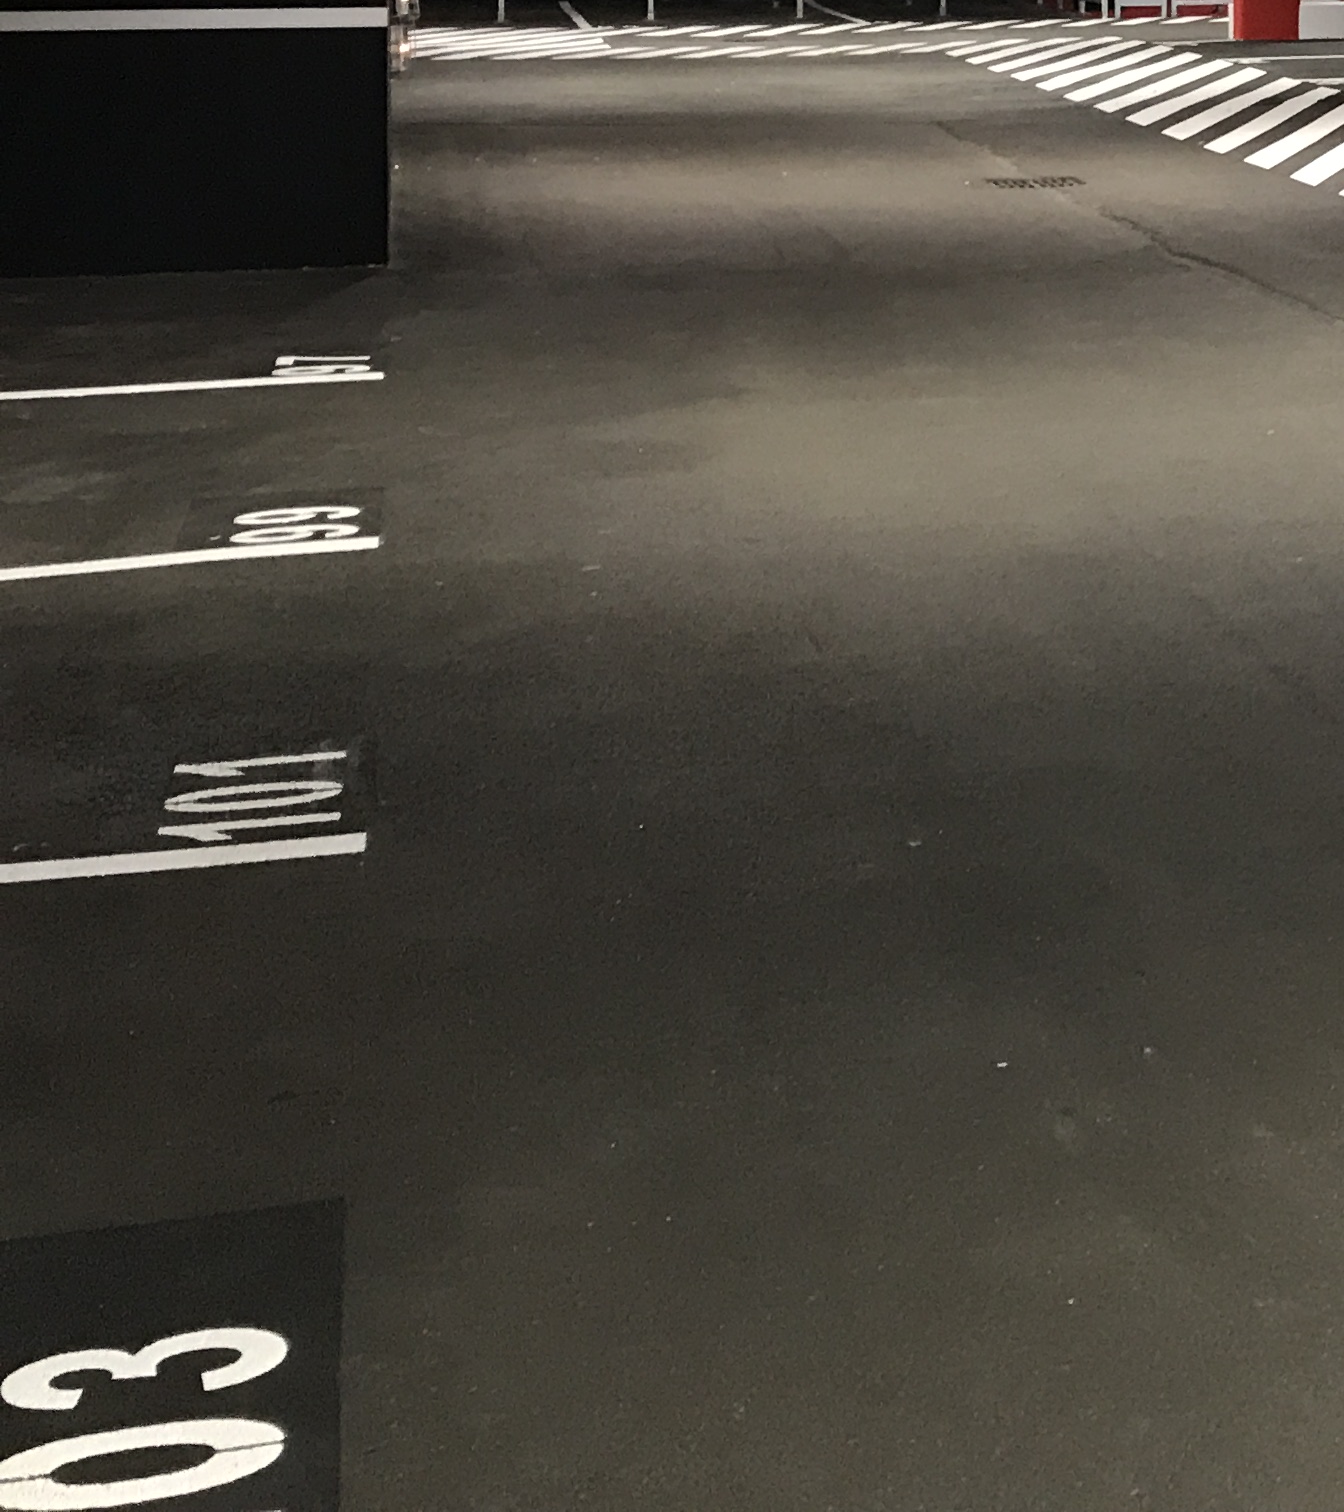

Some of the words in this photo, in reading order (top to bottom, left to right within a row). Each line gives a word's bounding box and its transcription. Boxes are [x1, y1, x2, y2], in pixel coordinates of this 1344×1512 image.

[230, 506, 361, 544] 99
[158, 750, 347, 841] 101
[0, 1327, 289, 1512] 03
